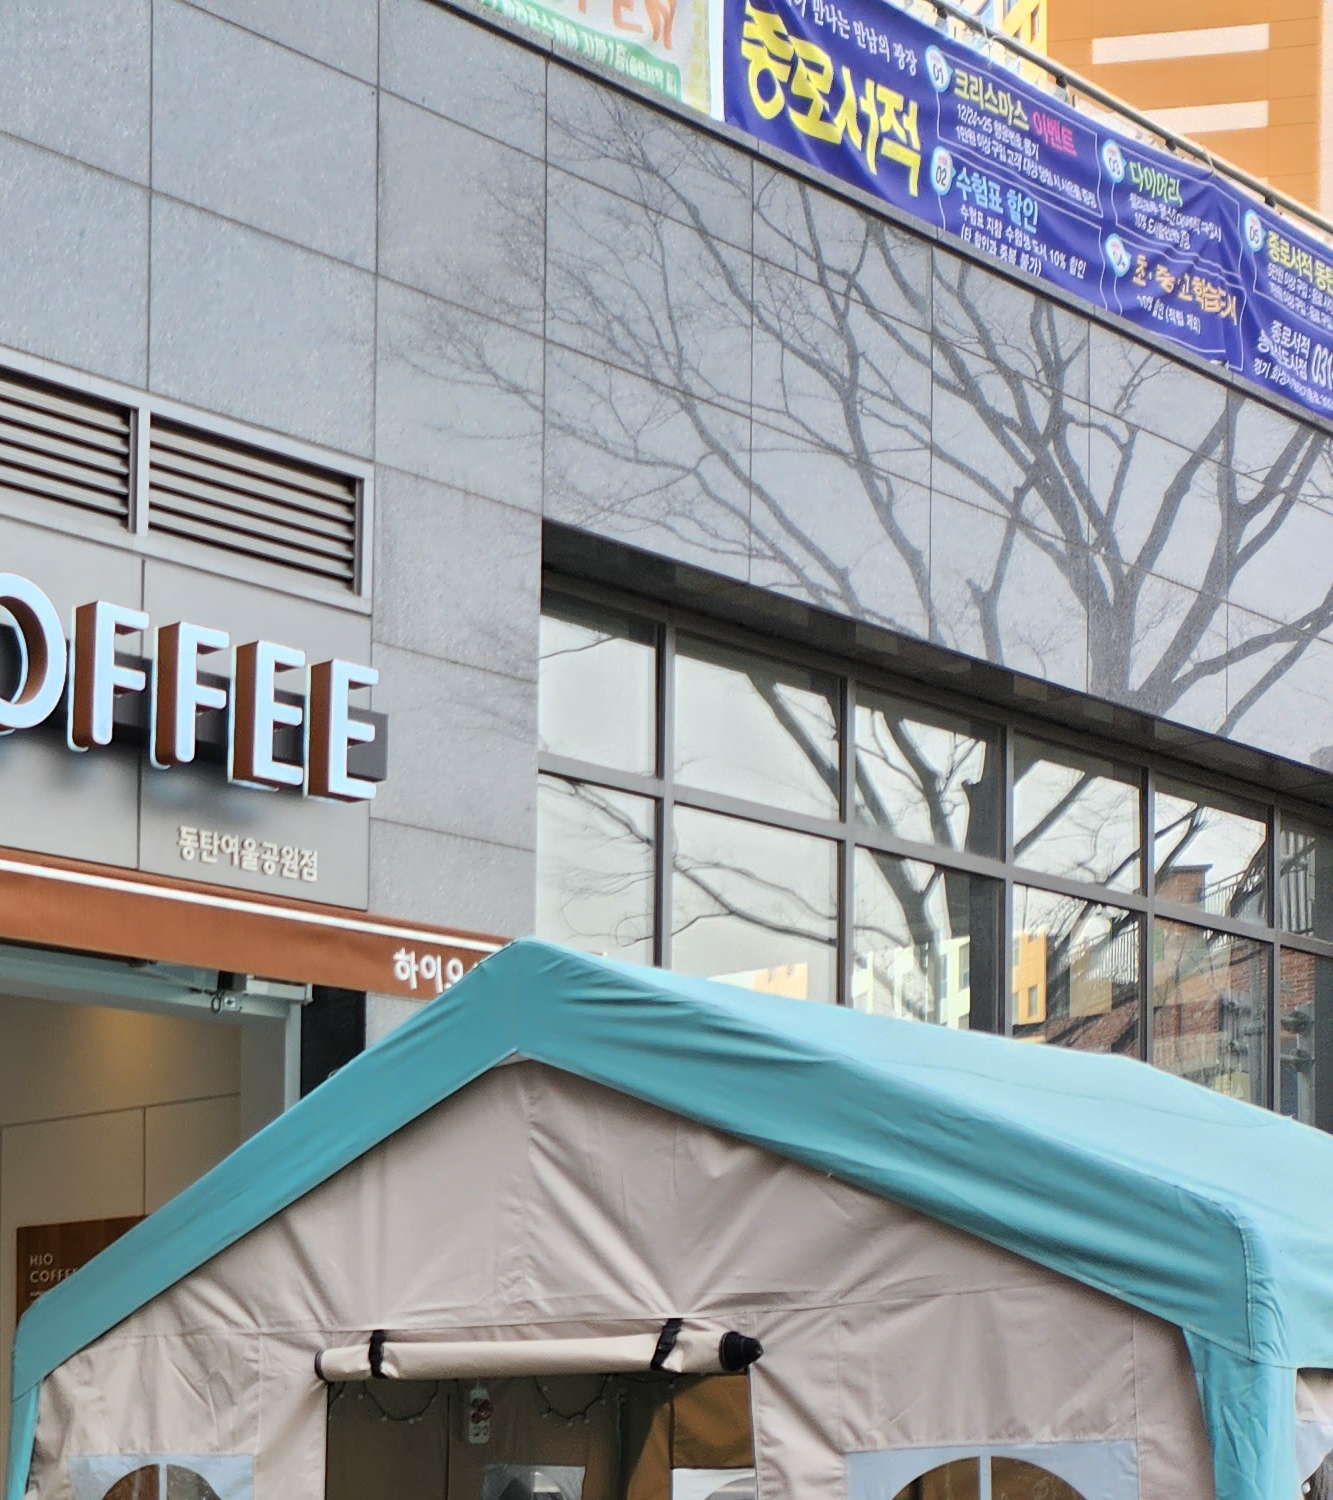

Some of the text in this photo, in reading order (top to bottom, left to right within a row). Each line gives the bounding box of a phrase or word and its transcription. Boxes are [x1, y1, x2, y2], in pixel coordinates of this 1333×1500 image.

[853, 20, 890, 62] 만남의
[893, 42, 918, 76] 광장
[933, 63, 945, 85] 01
[741, 0, 921, 197] 종로서적
[954, 68, 1077, 157] 크리스마스 이벤트
[935, 166, 948, 187] 02
[956, 166, 1004, 214] 수험표
[1006, 188, 1039, 234] 할인
[1129, 161, 1183, 207] 다이어리
[1268, 230, 1314, 284] 종로서적
[1271, 320, 1311, 360] 종로서적
[176, 823, 321, 884] 동탄여울공원점
[30, 1252, 53, 1266] HIO
